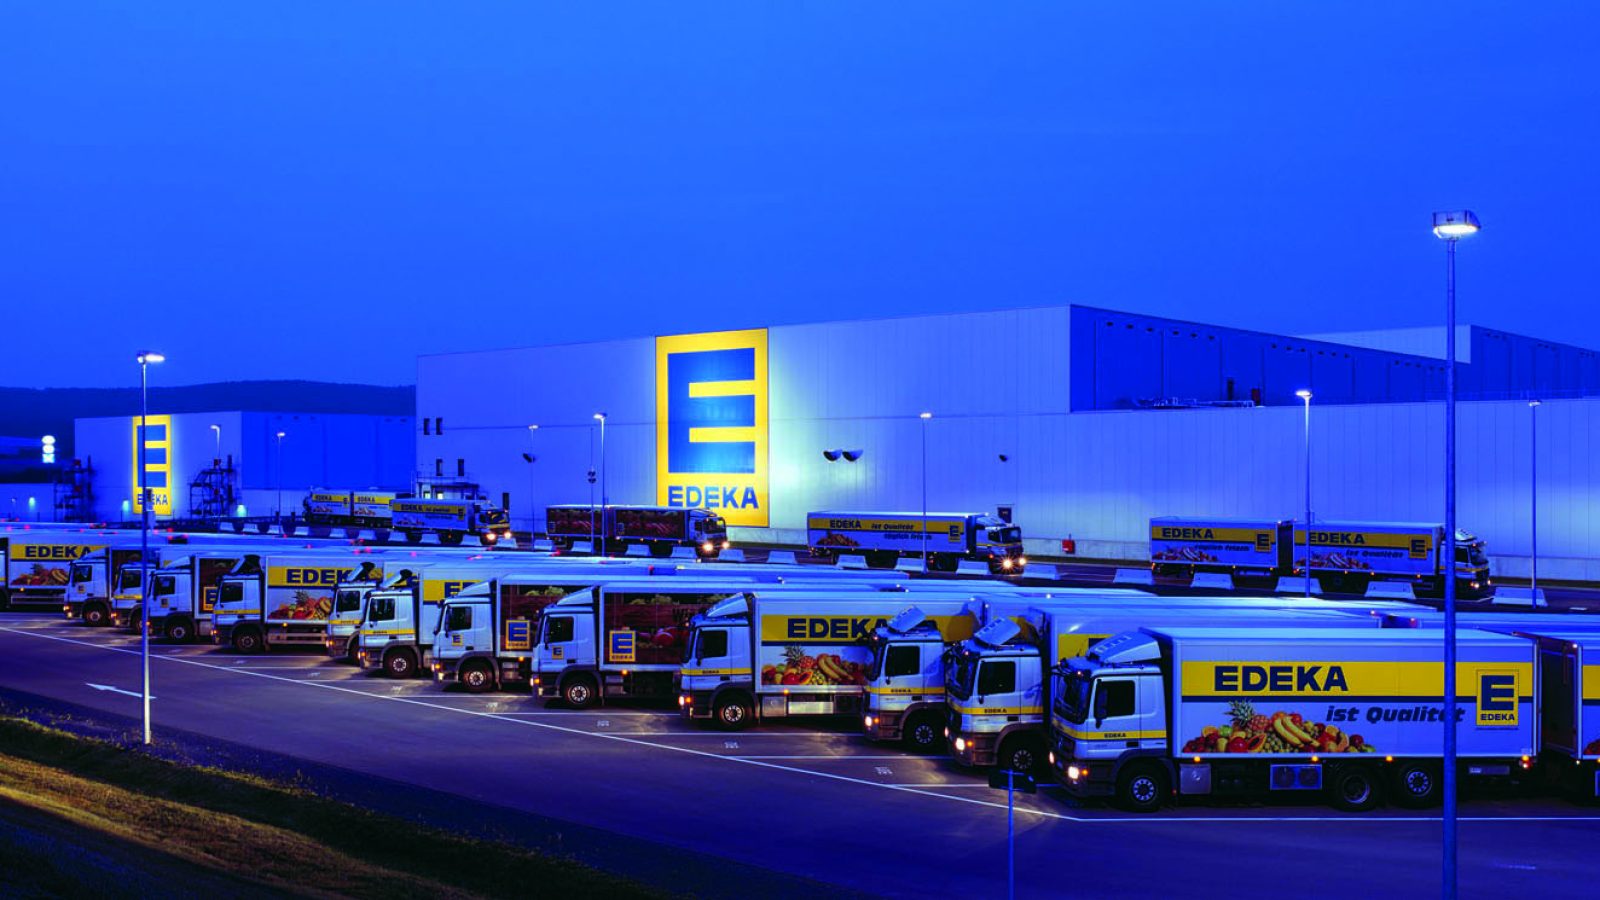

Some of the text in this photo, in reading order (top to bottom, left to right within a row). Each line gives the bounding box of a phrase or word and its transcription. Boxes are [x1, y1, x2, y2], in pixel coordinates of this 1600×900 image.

[667, 347, 755, 474] E
[668, 485, 759, 509] EDEKA
[830, 519, 862, 529] EDEKA
[949, 525, 960, 537] E
[1162, 528, 1214, 539] EDEKA
[1257, 533, 1269, 546] E
[1309, 532, 1365, 545] EDEKA
[1411, 540, 1425, 553] E
[286, 569, 353, 584] EDEK
[509, 622, 527, 642] E
[613, 633, 632, 654] E
[1214, 665, 1349, 692] EDEKA
[1481, 675, 1515, 711] E
[1326, 705, 1359, 721] ist
[1480, 713, 1515, 721] EDEKA
